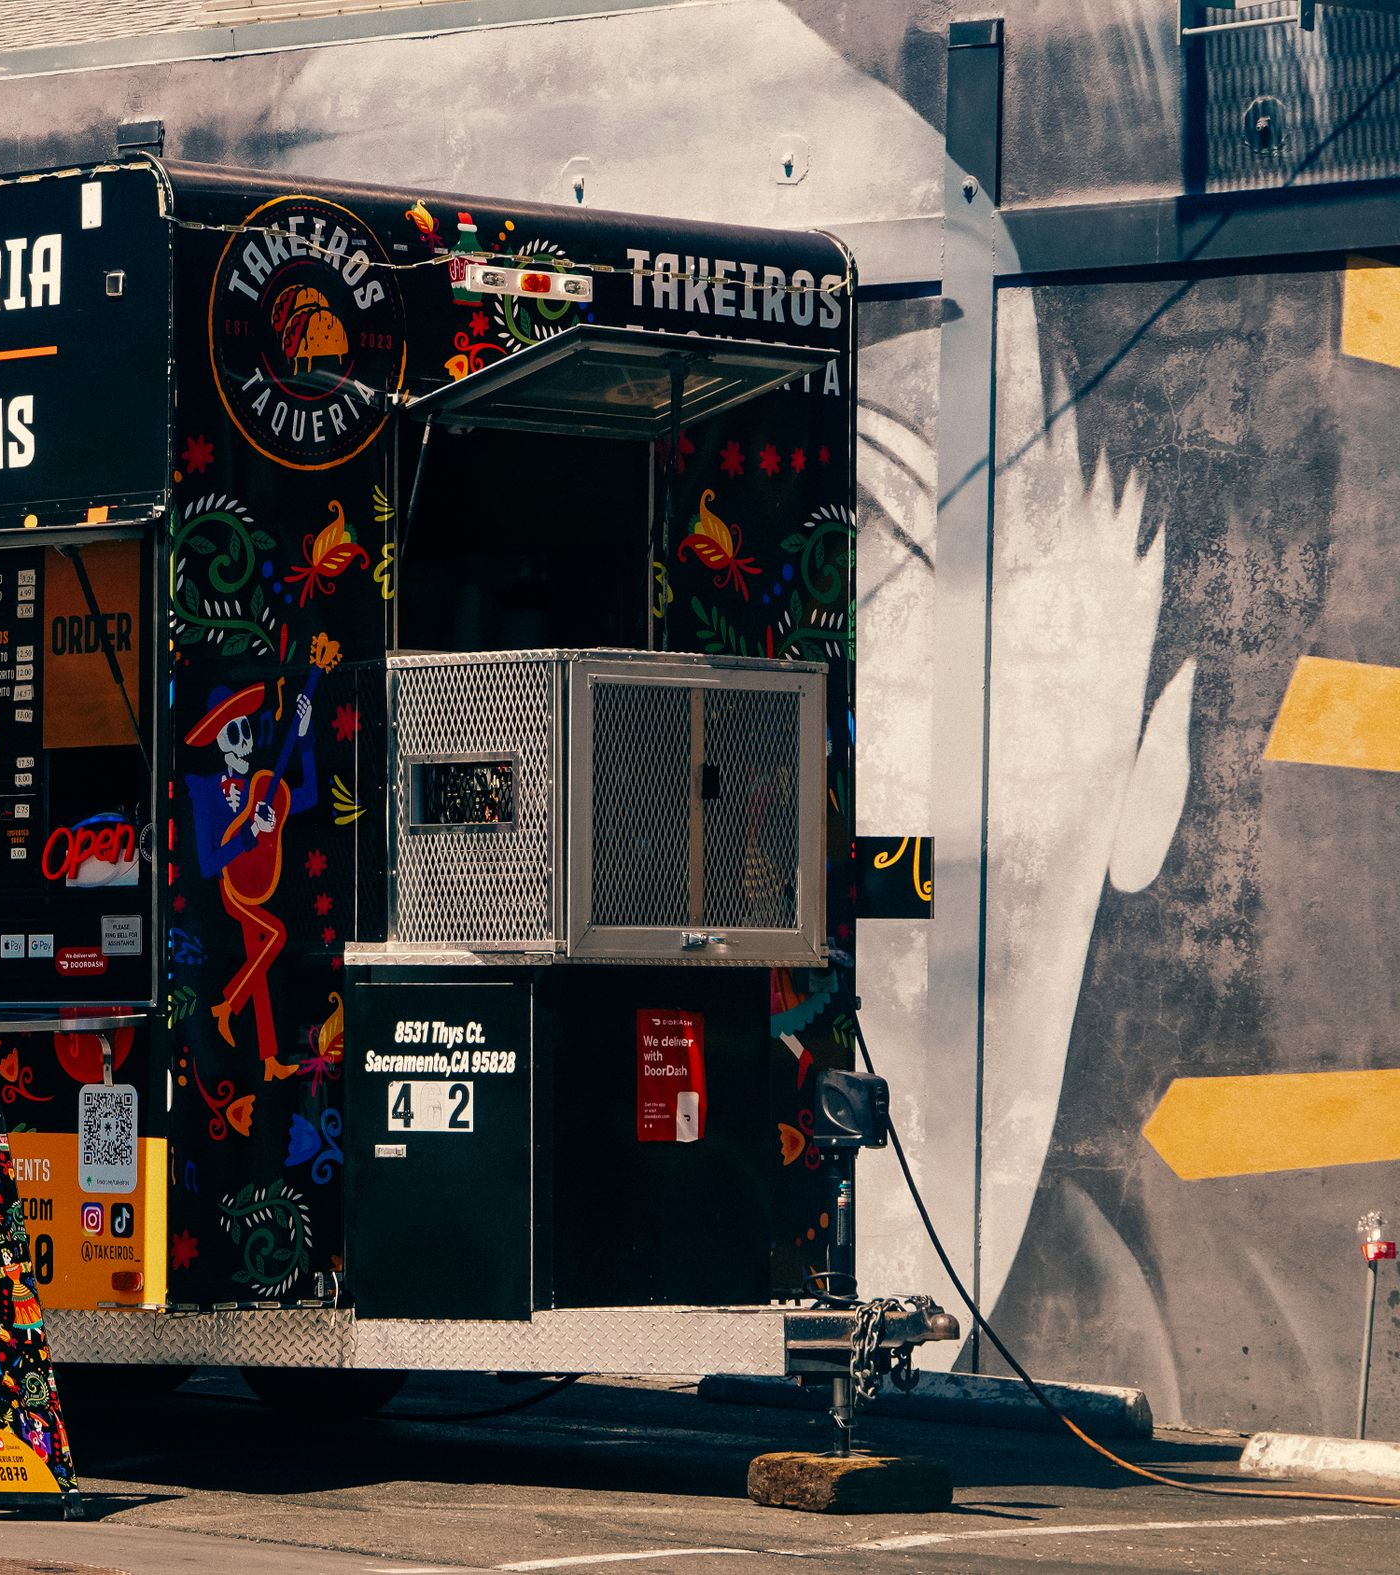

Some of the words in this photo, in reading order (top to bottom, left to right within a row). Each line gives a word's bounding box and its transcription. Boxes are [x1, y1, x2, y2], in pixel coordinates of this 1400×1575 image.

[228, 215, 385, 310] TAKEIROS
[626, 248, 842, 329] TAKEIROS
[360, 332, 392, 349] 2023
[241, 367, 376, 442] TAQUERIA
[52, 612, 132, 655] ORDER
[11, 941, 22, 952] Pay
[40, 941, 52, 952] Pay
[70, 961, 104, 969] DOORDASH
[394, 1020, 430, 1044] 8531
[432, 1021, 464, 1049] Thys
[466, 1021, 486, 1044] Ct.
[643, 1035, 659, 1047] We
[471, 1051, 517, 1074] 95828
[644, 1050, 663, 1062] with
[644, 1065, 688, 1076] DoorDash
[448, 1083, 470, 1129] 2
